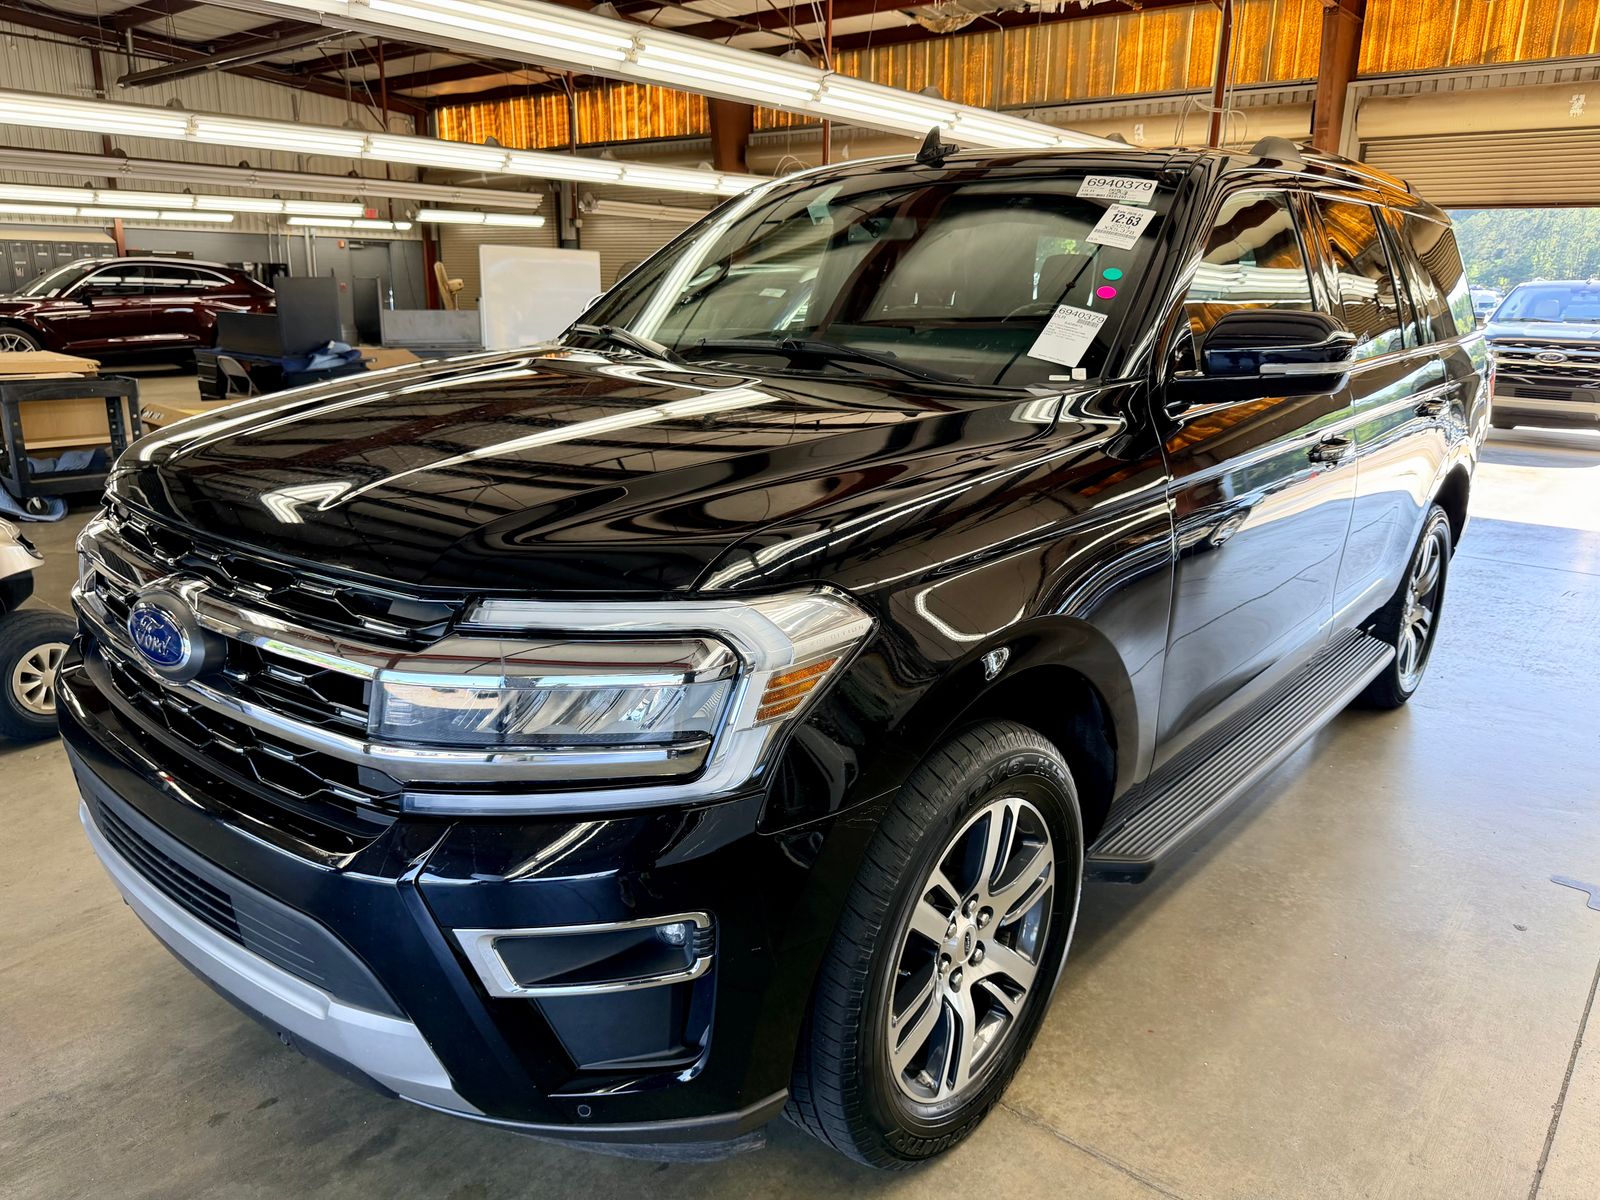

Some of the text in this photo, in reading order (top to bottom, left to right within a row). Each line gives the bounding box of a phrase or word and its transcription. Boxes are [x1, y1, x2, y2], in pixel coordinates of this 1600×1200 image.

[1087, 178, 1153, 191] 6940379
[1110, 212, 1142, 227] 12:63
[1058, 307, 1105, 324] 6940379
[136, 615, 171, 656] Ford
